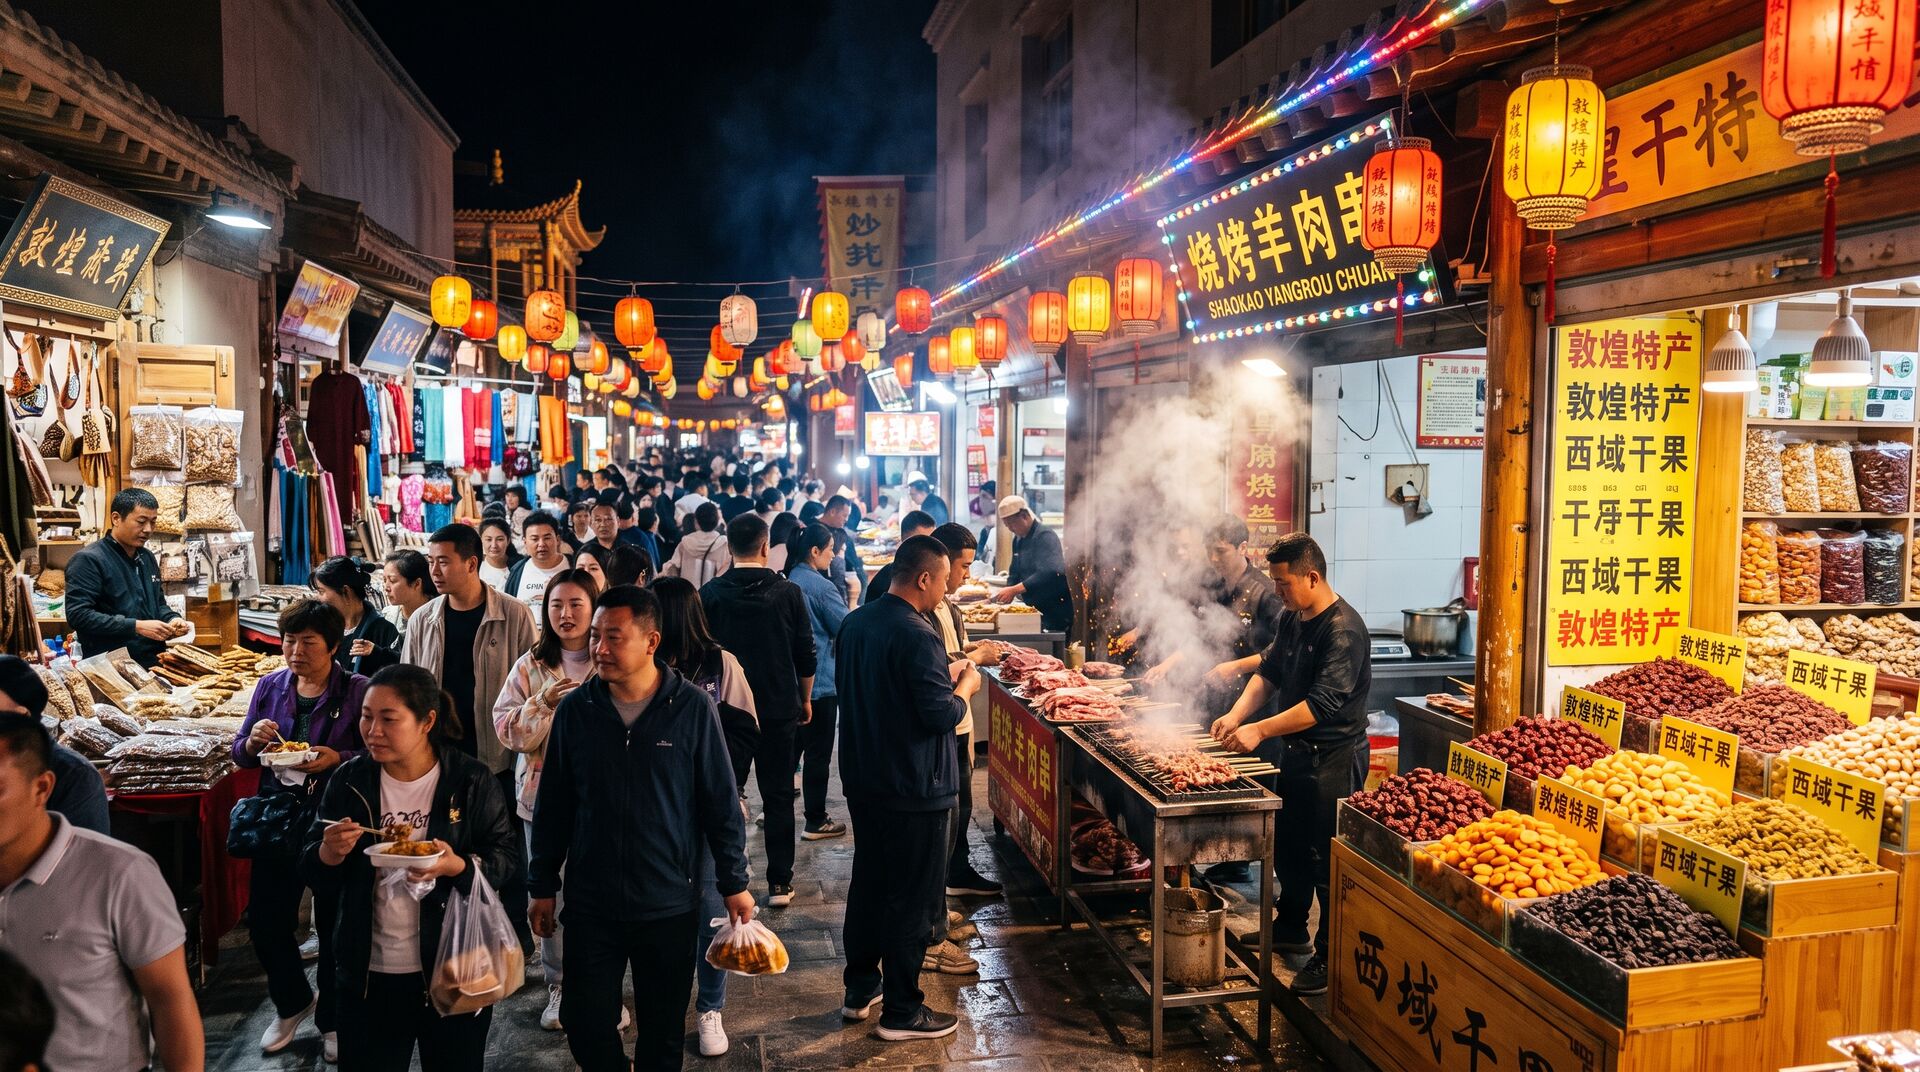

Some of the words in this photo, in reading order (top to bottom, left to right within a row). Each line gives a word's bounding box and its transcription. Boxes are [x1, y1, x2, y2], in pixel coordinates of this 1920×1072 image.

[1208, 290, 1265, 320] SHAOKAO
[1264, 272, 1334, 308] YANGROU
[1567, 328, 1693, 371] 敦煌特产
[1566, 381, 1691, 422] 敦煌特产
[1565, 433, 1689, 474] 西域干果
[1560, 556, 1683, 595] 西域干果
[1557, 607, 1681, 649] 敦煌特产
[1679, 635, 1743, 666] 敦煌特产
[1791, 660, 1868, 698] 西域干果
[1564, 693, 1620, 729] 敦煌特产
[1664, 725, 1731, 769] 西域干果
[1538, 785, 1600, 834] 敦煌特果
[1791, 768, 1877, 821] 西域干果
[1659, 841, 1737, 898] 西域干果
